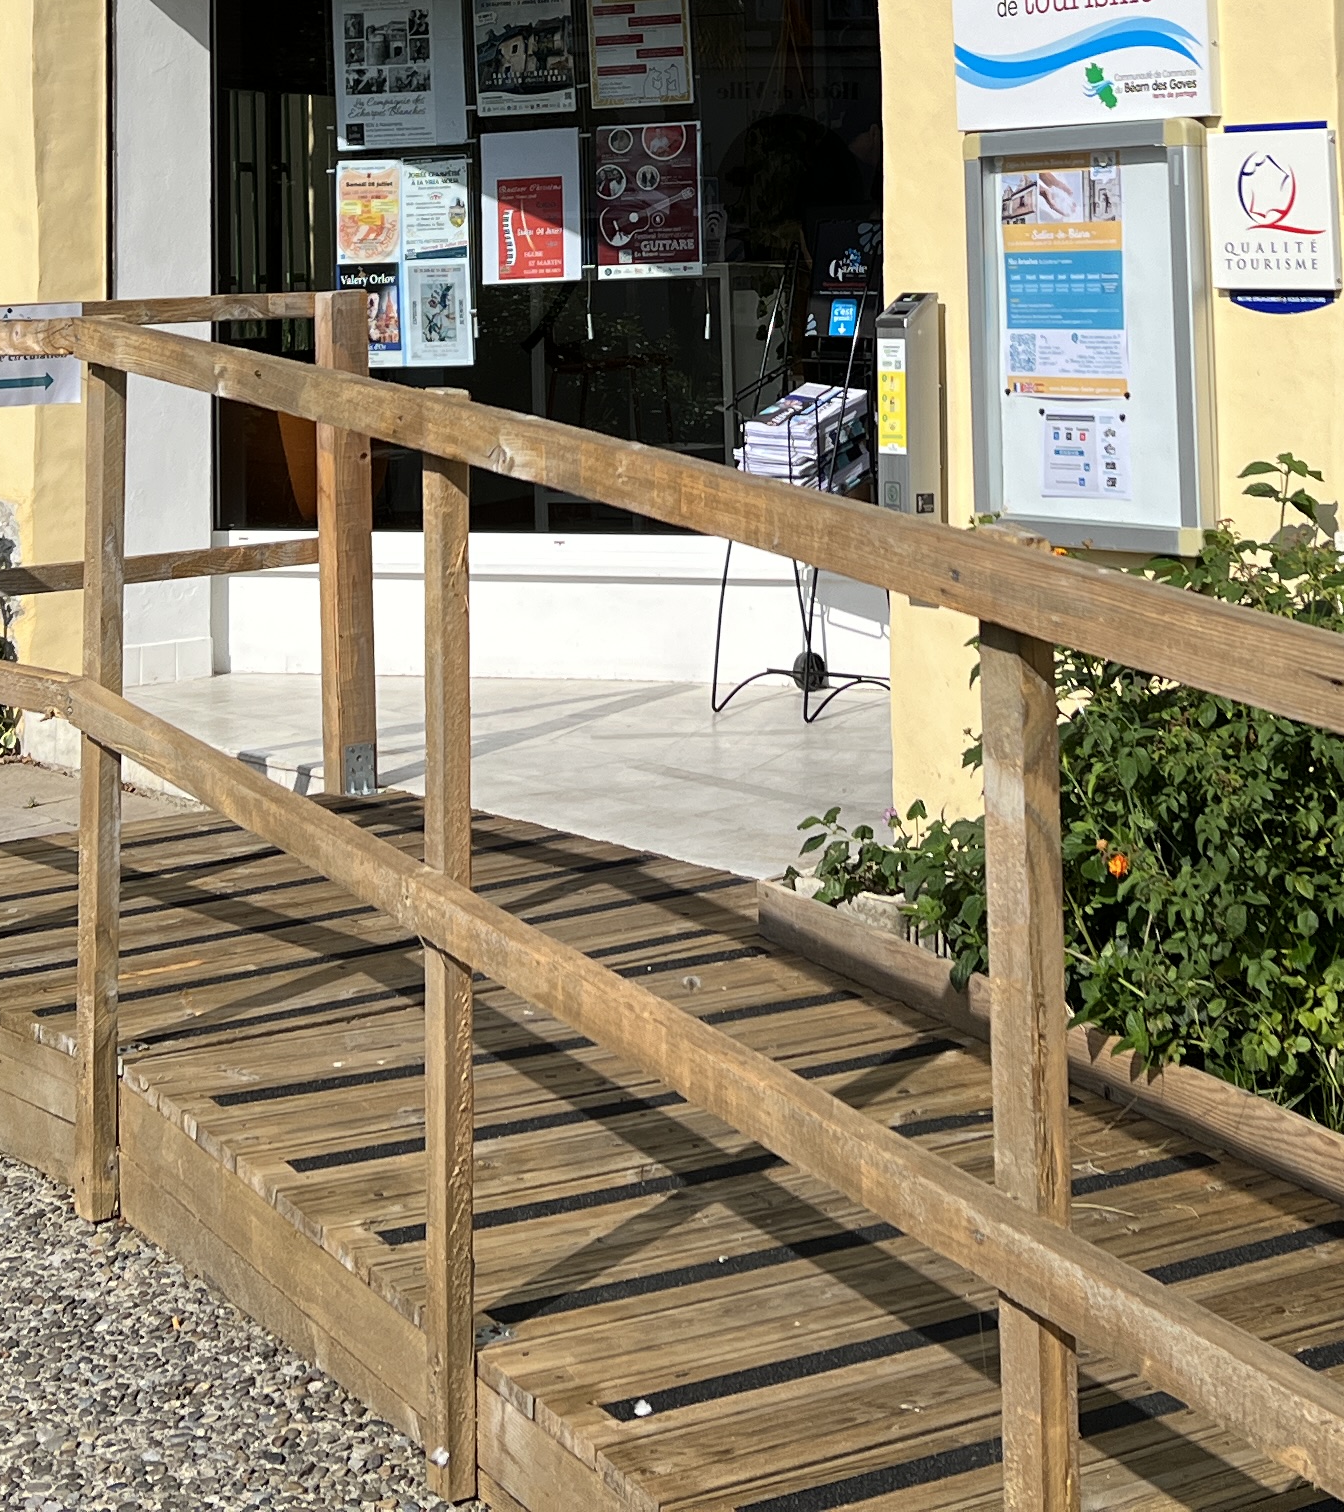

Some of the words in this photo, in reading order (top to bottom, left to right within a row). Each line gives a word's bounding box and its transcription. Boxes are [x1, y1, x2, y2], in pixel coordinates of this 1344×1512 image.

[1124, 80, 1150, 93] Béarn
[1152, 80, 1168, 91] des
[1170, 78, 1197, 90] Gaves
[640, 238, 695, 252] GUITARE
[1224, 238, 1318, 256] QUALITÉ
[1224, 258, 1318, 270] TOURISME
[340, 274, 368, 287] Valery
[369, 272, 396, 284] Orlov
